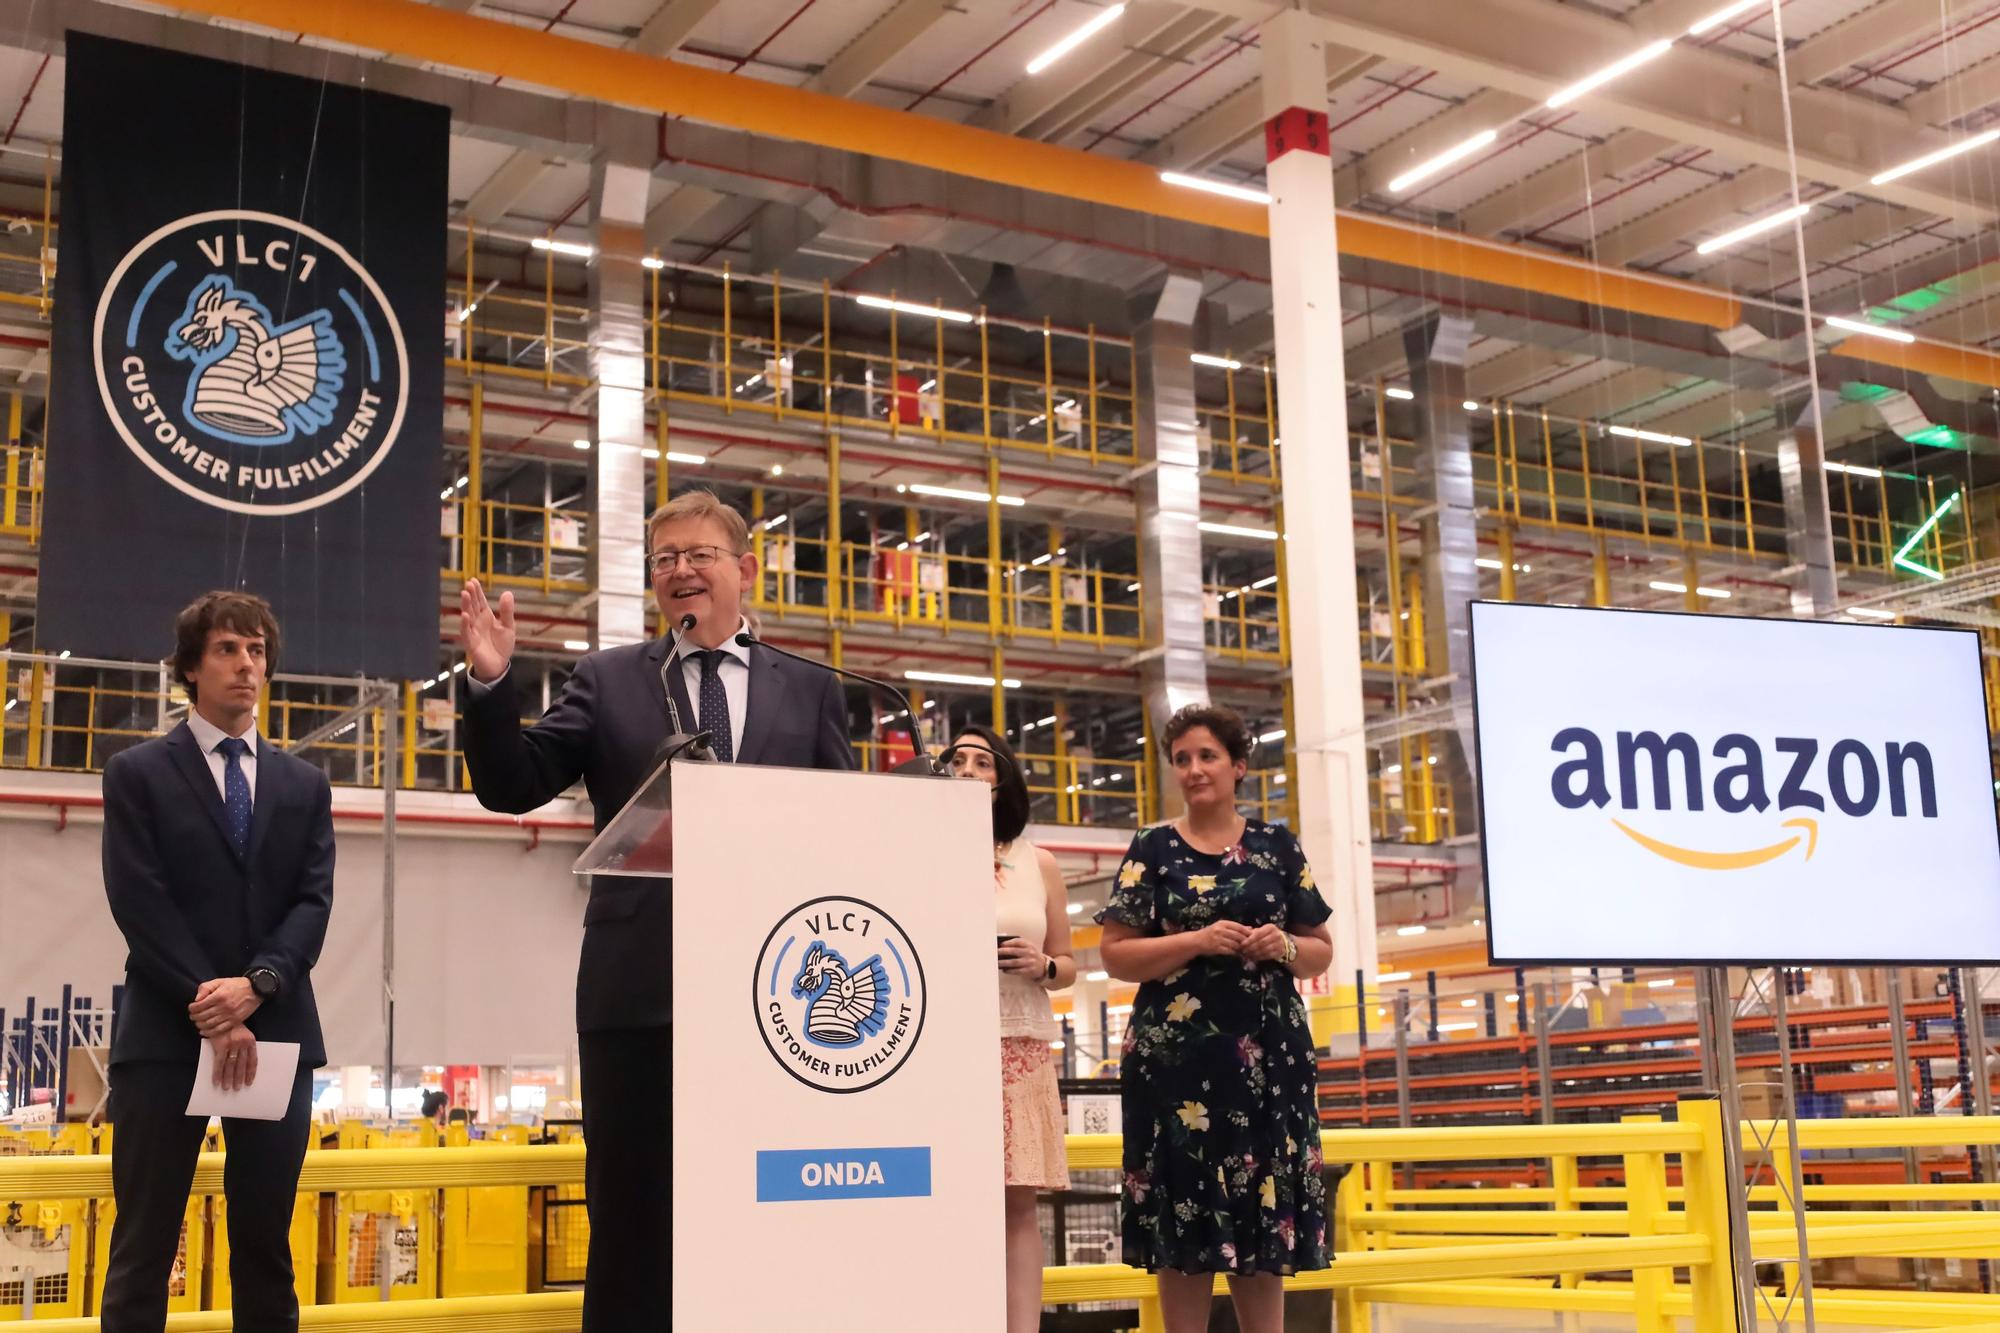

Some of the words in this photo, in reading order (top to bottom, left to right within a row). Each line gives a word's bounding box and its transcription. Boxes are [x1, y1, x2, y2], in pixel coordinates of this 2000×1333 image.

[197, 234, 316, 282] VLC1
[122, 356, 229, 482] CUSTOMER
[238, 388, 381, 489] FULFILLMENT
[1551, 727, 1938, 818] amazon
[805, 912, 871, 937] VLC1
[769, 1001, 830, 1075] CUSTOMER
[835, 1003, 912, 1077] FULFILLMENT
[801, 1161, 885, 1187] ONDA
